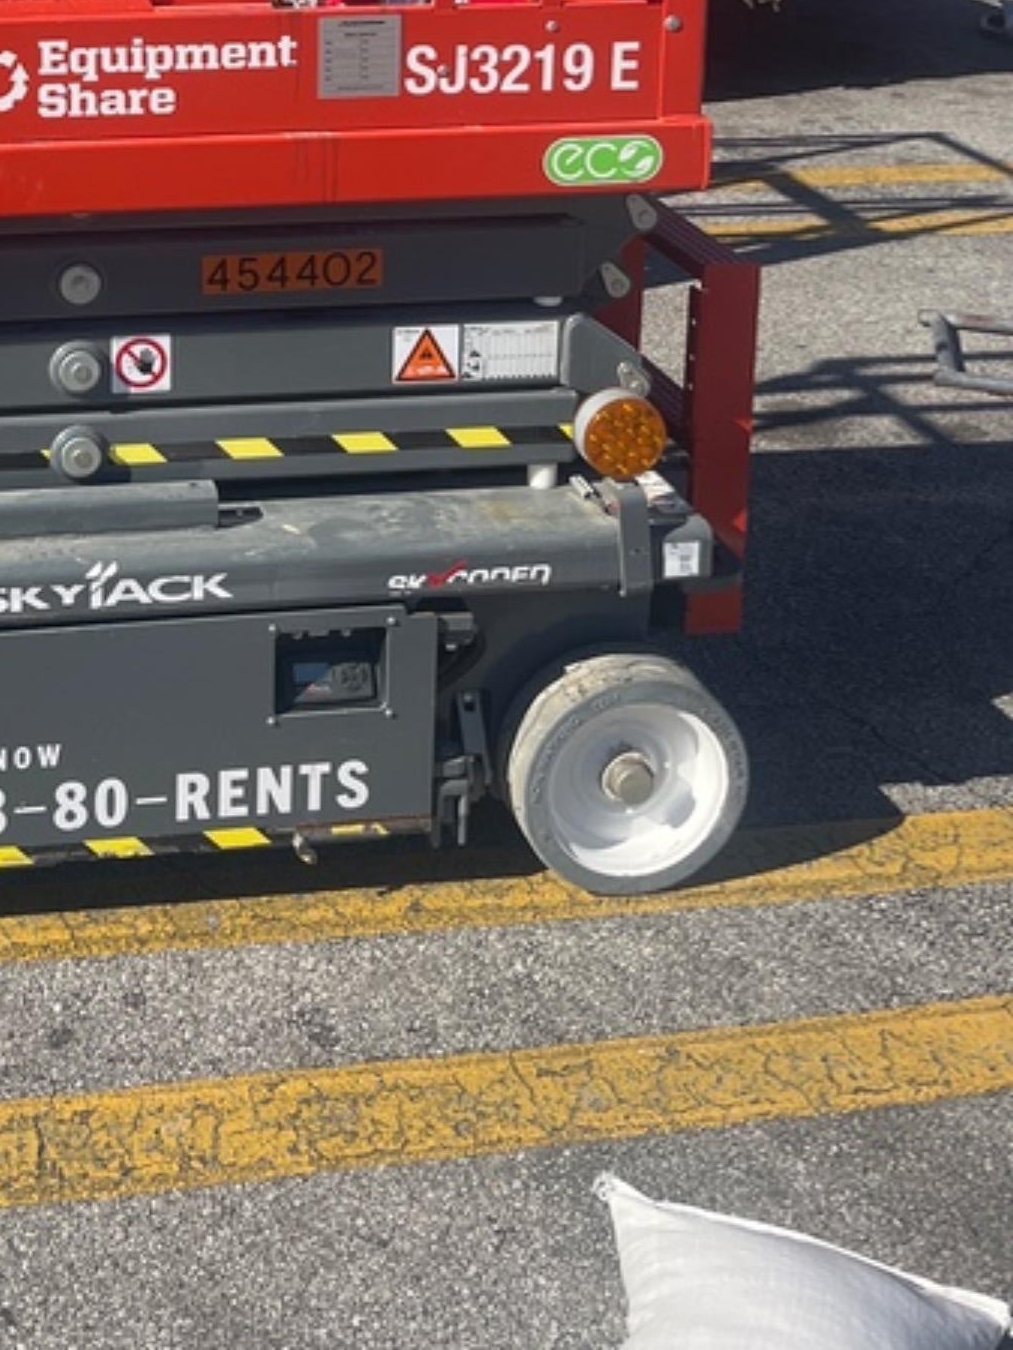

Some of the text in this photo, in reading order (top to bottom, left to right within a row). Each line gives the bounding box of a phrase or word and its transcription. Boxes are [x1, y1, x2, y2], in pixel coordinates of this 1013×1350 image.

[38, 35, 297, 81] Equipment
[404, 41, 641, 94] SJ3219 E
[38, 83, 175, 117] Share
[207, 251, 378, 291] 454402
